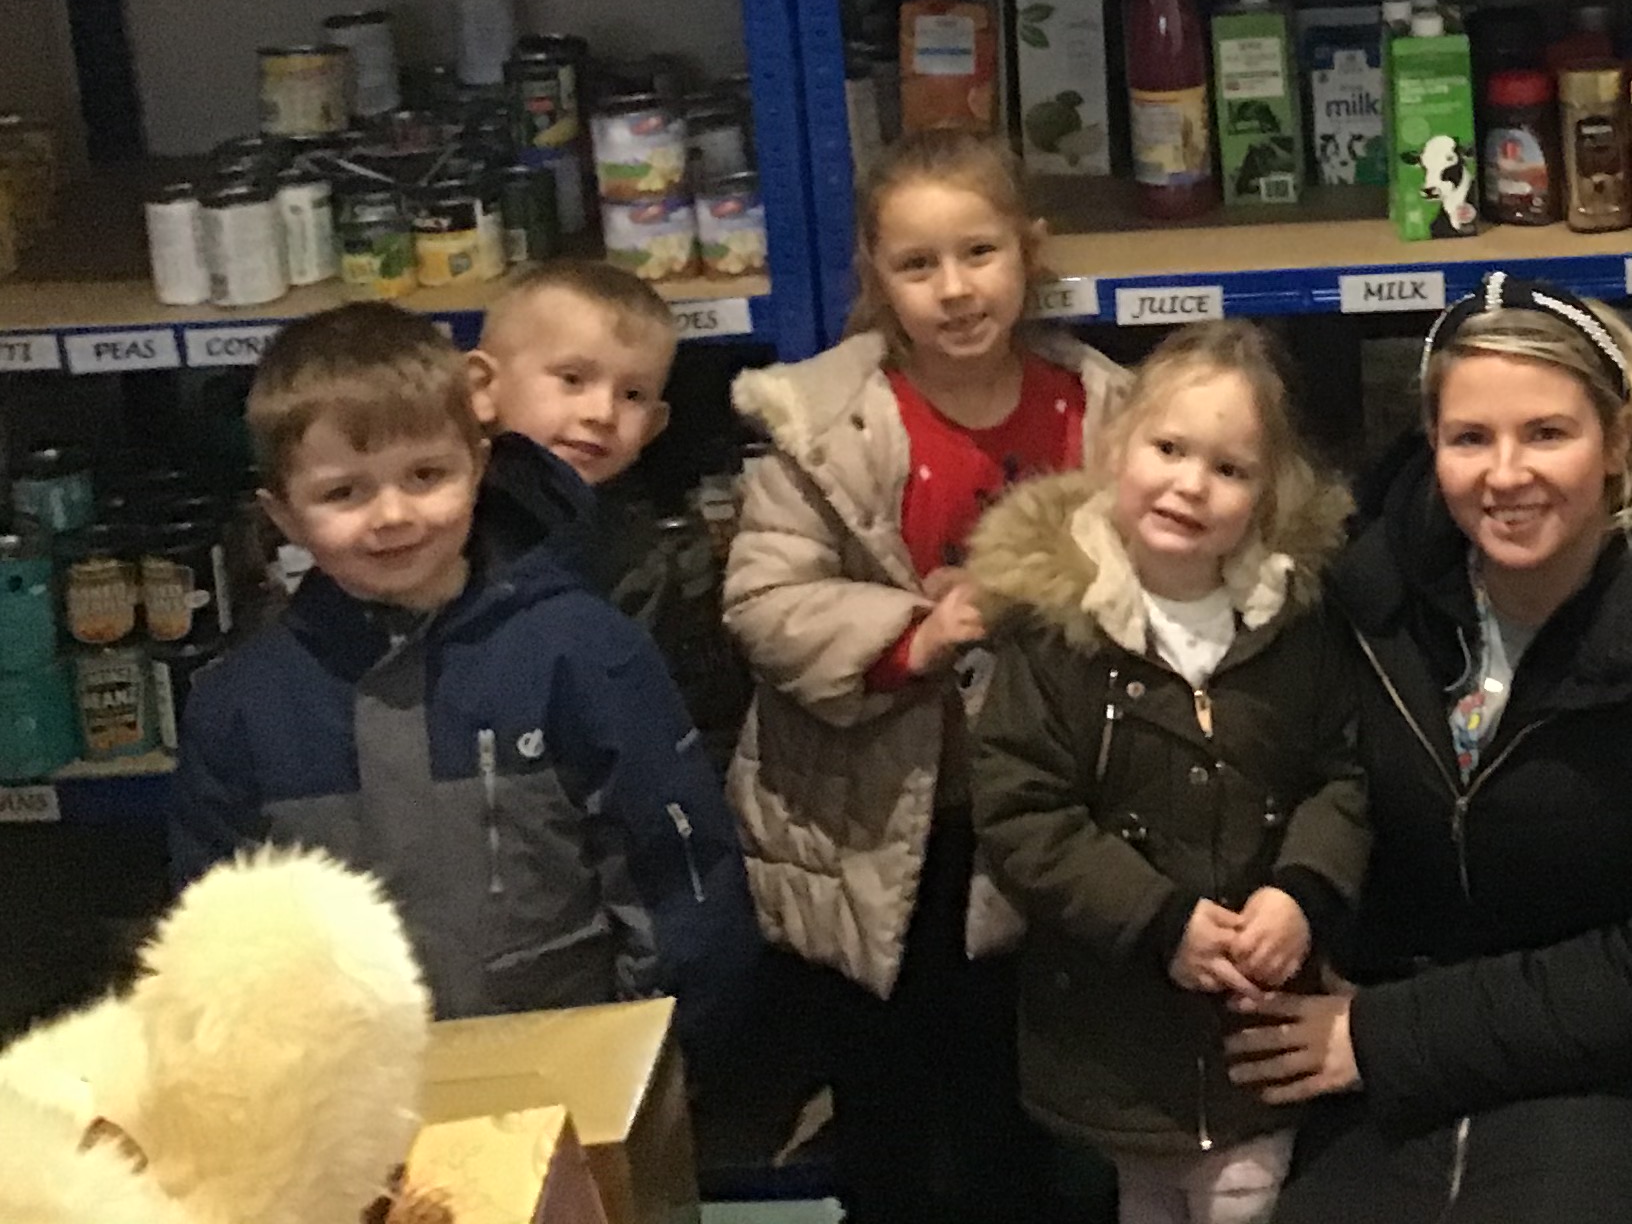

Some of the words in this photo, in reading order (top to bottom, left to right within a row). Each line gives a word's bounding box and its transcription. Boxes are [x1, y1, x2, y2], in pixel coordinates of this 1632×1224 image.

[1325, 90, 1382, 118] milk
[1362, 281, 1427, 302] MILK
[1131, 295, 1210, 318] JUICE
[675, 310, 718, 332] OES
[93, 339, 156, 362] PEAS
